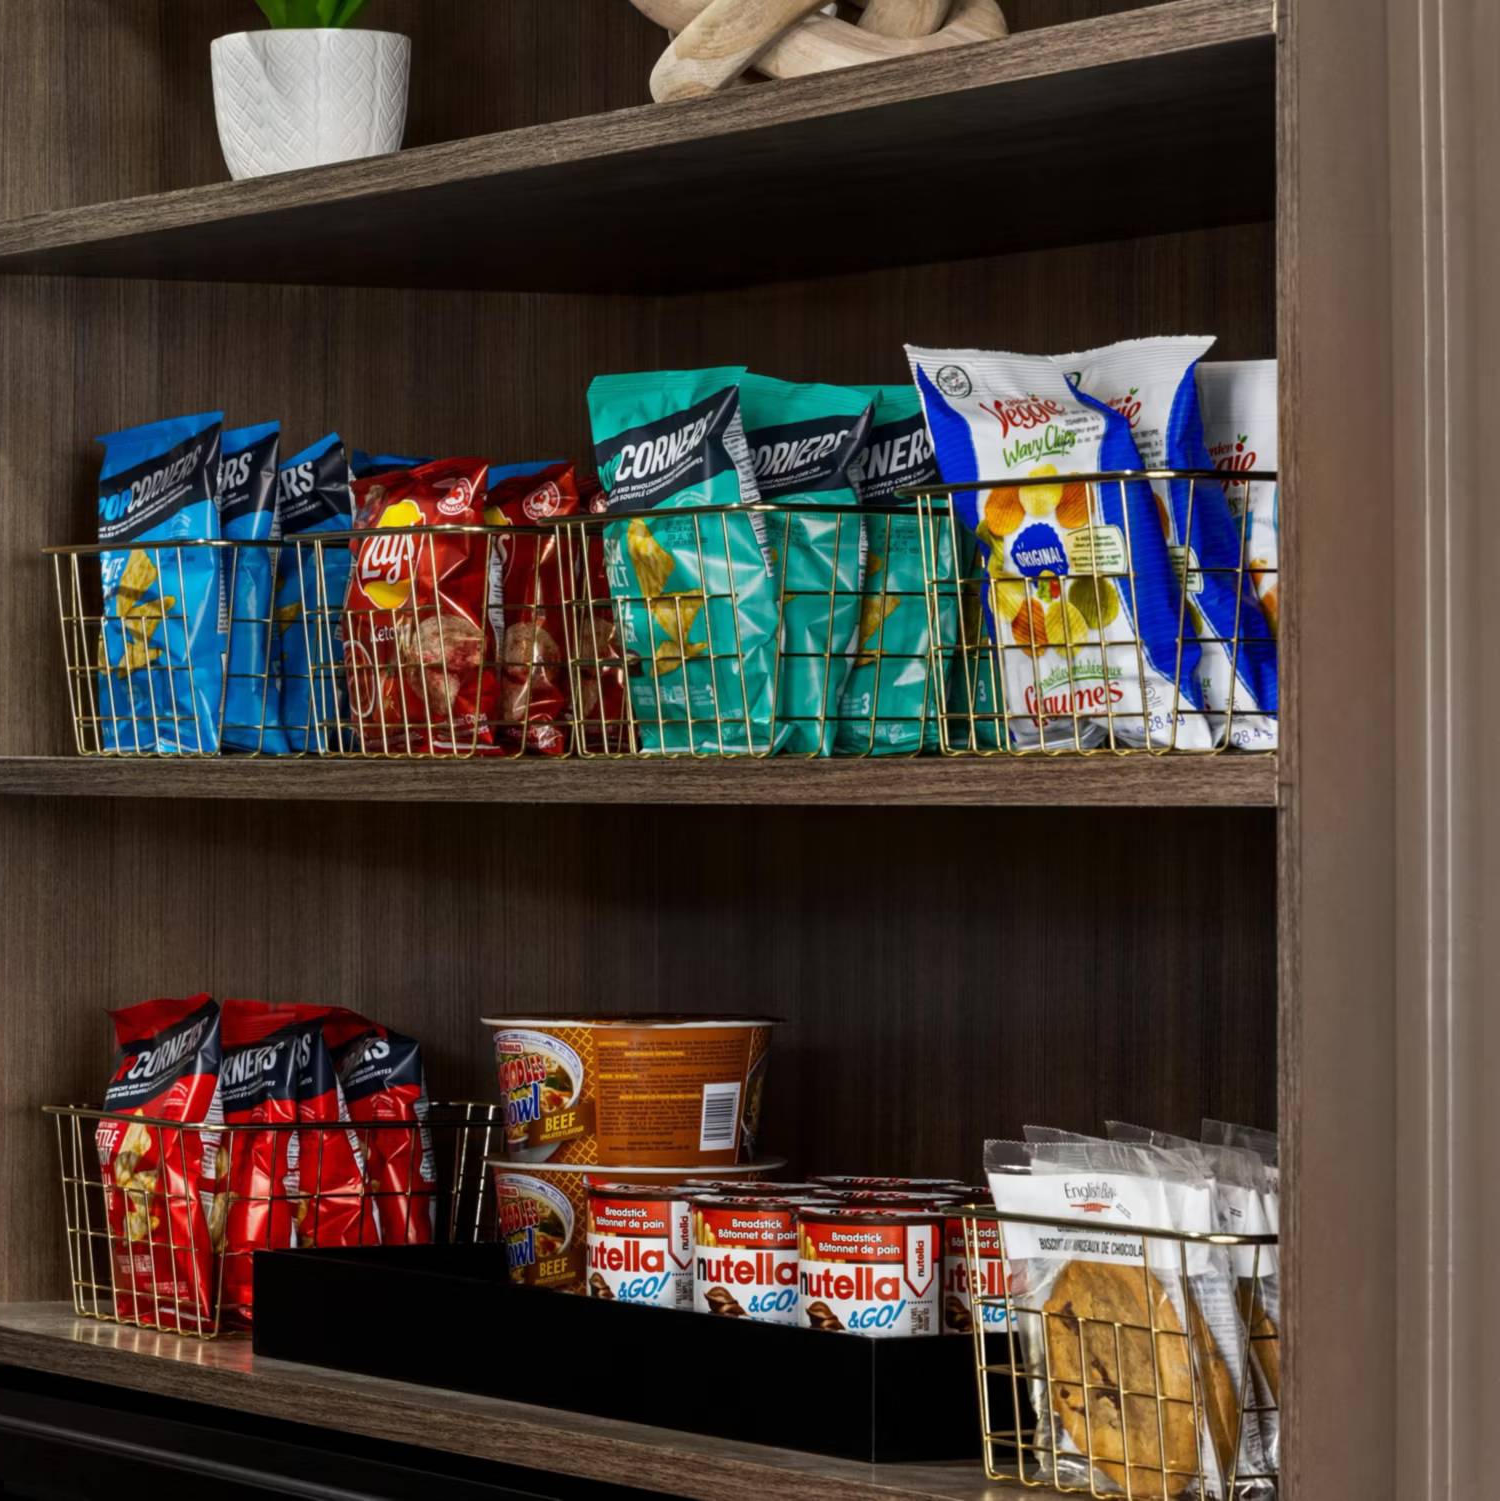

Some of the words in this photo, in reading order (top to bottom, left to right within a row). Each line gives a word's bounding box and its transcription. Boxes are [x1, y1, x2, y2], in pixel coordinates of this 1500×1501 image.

[979, 396, 1066, 439] Veggie
[1003, 437, 1043, 468] Wavy
[1015, 547, 1063, 567] ORIGINAL
[545, 1111, 576, 1132] BEEF
[605, 1206, 647, 1217] Breadstick
[628, 1219, 640, 1228] de
[643, 1219, 664, 1230] pain
[680, 1215, 689, 1251] nutella
[731, 1218, 782, 1229] Breadstick
[718, 1229, 758, 1239] Bâtonnet
[761, 1231, 774, 1240] de
[831, 1232, 882, 1243] Breadstick
[818, 1242, 858, 1254] Bâtonnet
[860, 1244, 874, 1254] de
[876, 1244, 900, 1256] pain
[916, 1240, 925, 1277] nutella
[1101, 1241, 1110, 1255] DE
[1111, 1243, 1143, 1257] CHOCOLA
[540, 1258, 568, 1277] BEEF
[697, 1252, 798, 1286] nutella
[800, 1266, 900, 1301] nutella
